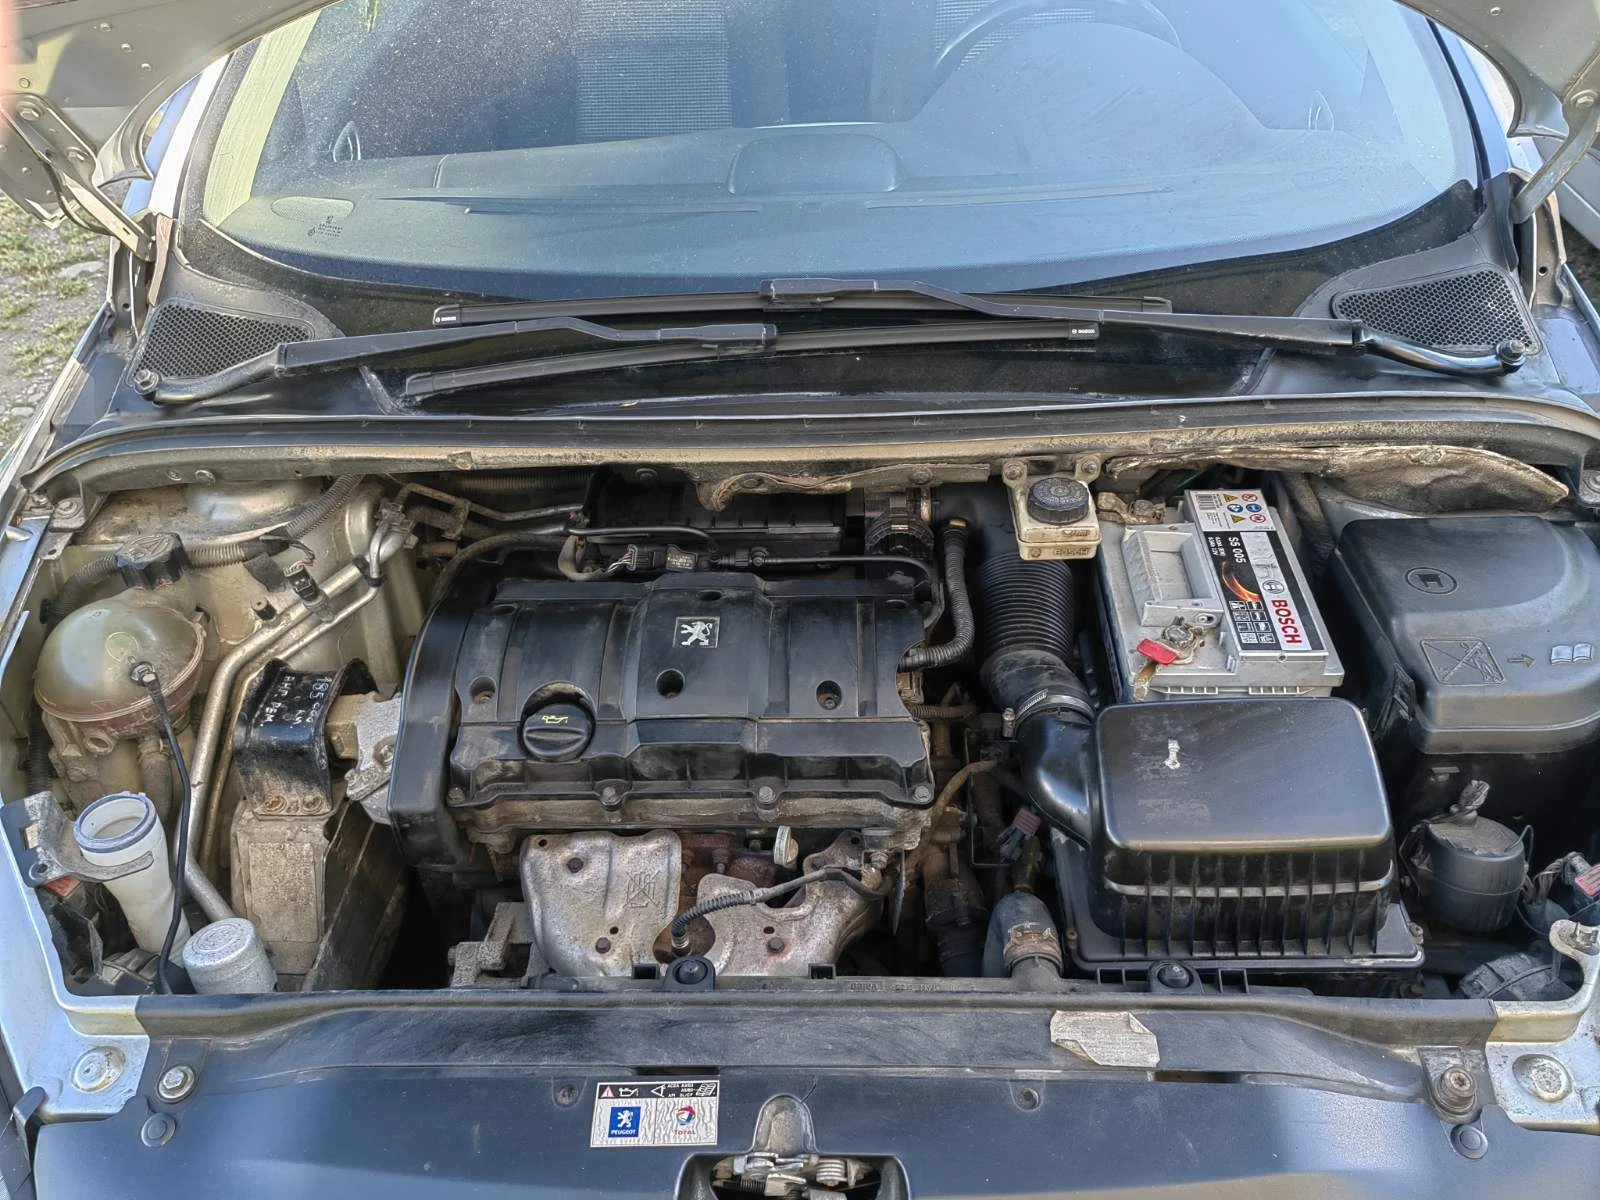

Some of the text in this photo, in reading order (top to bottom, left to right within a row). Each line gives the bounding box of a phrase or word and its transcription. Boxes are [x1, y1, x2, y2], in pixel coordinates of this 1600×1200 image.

[1232, 548, 1247, 564] 005
[1271, 599, 1303, 644] BOSCH
[310, 676, 333, 699] 185
